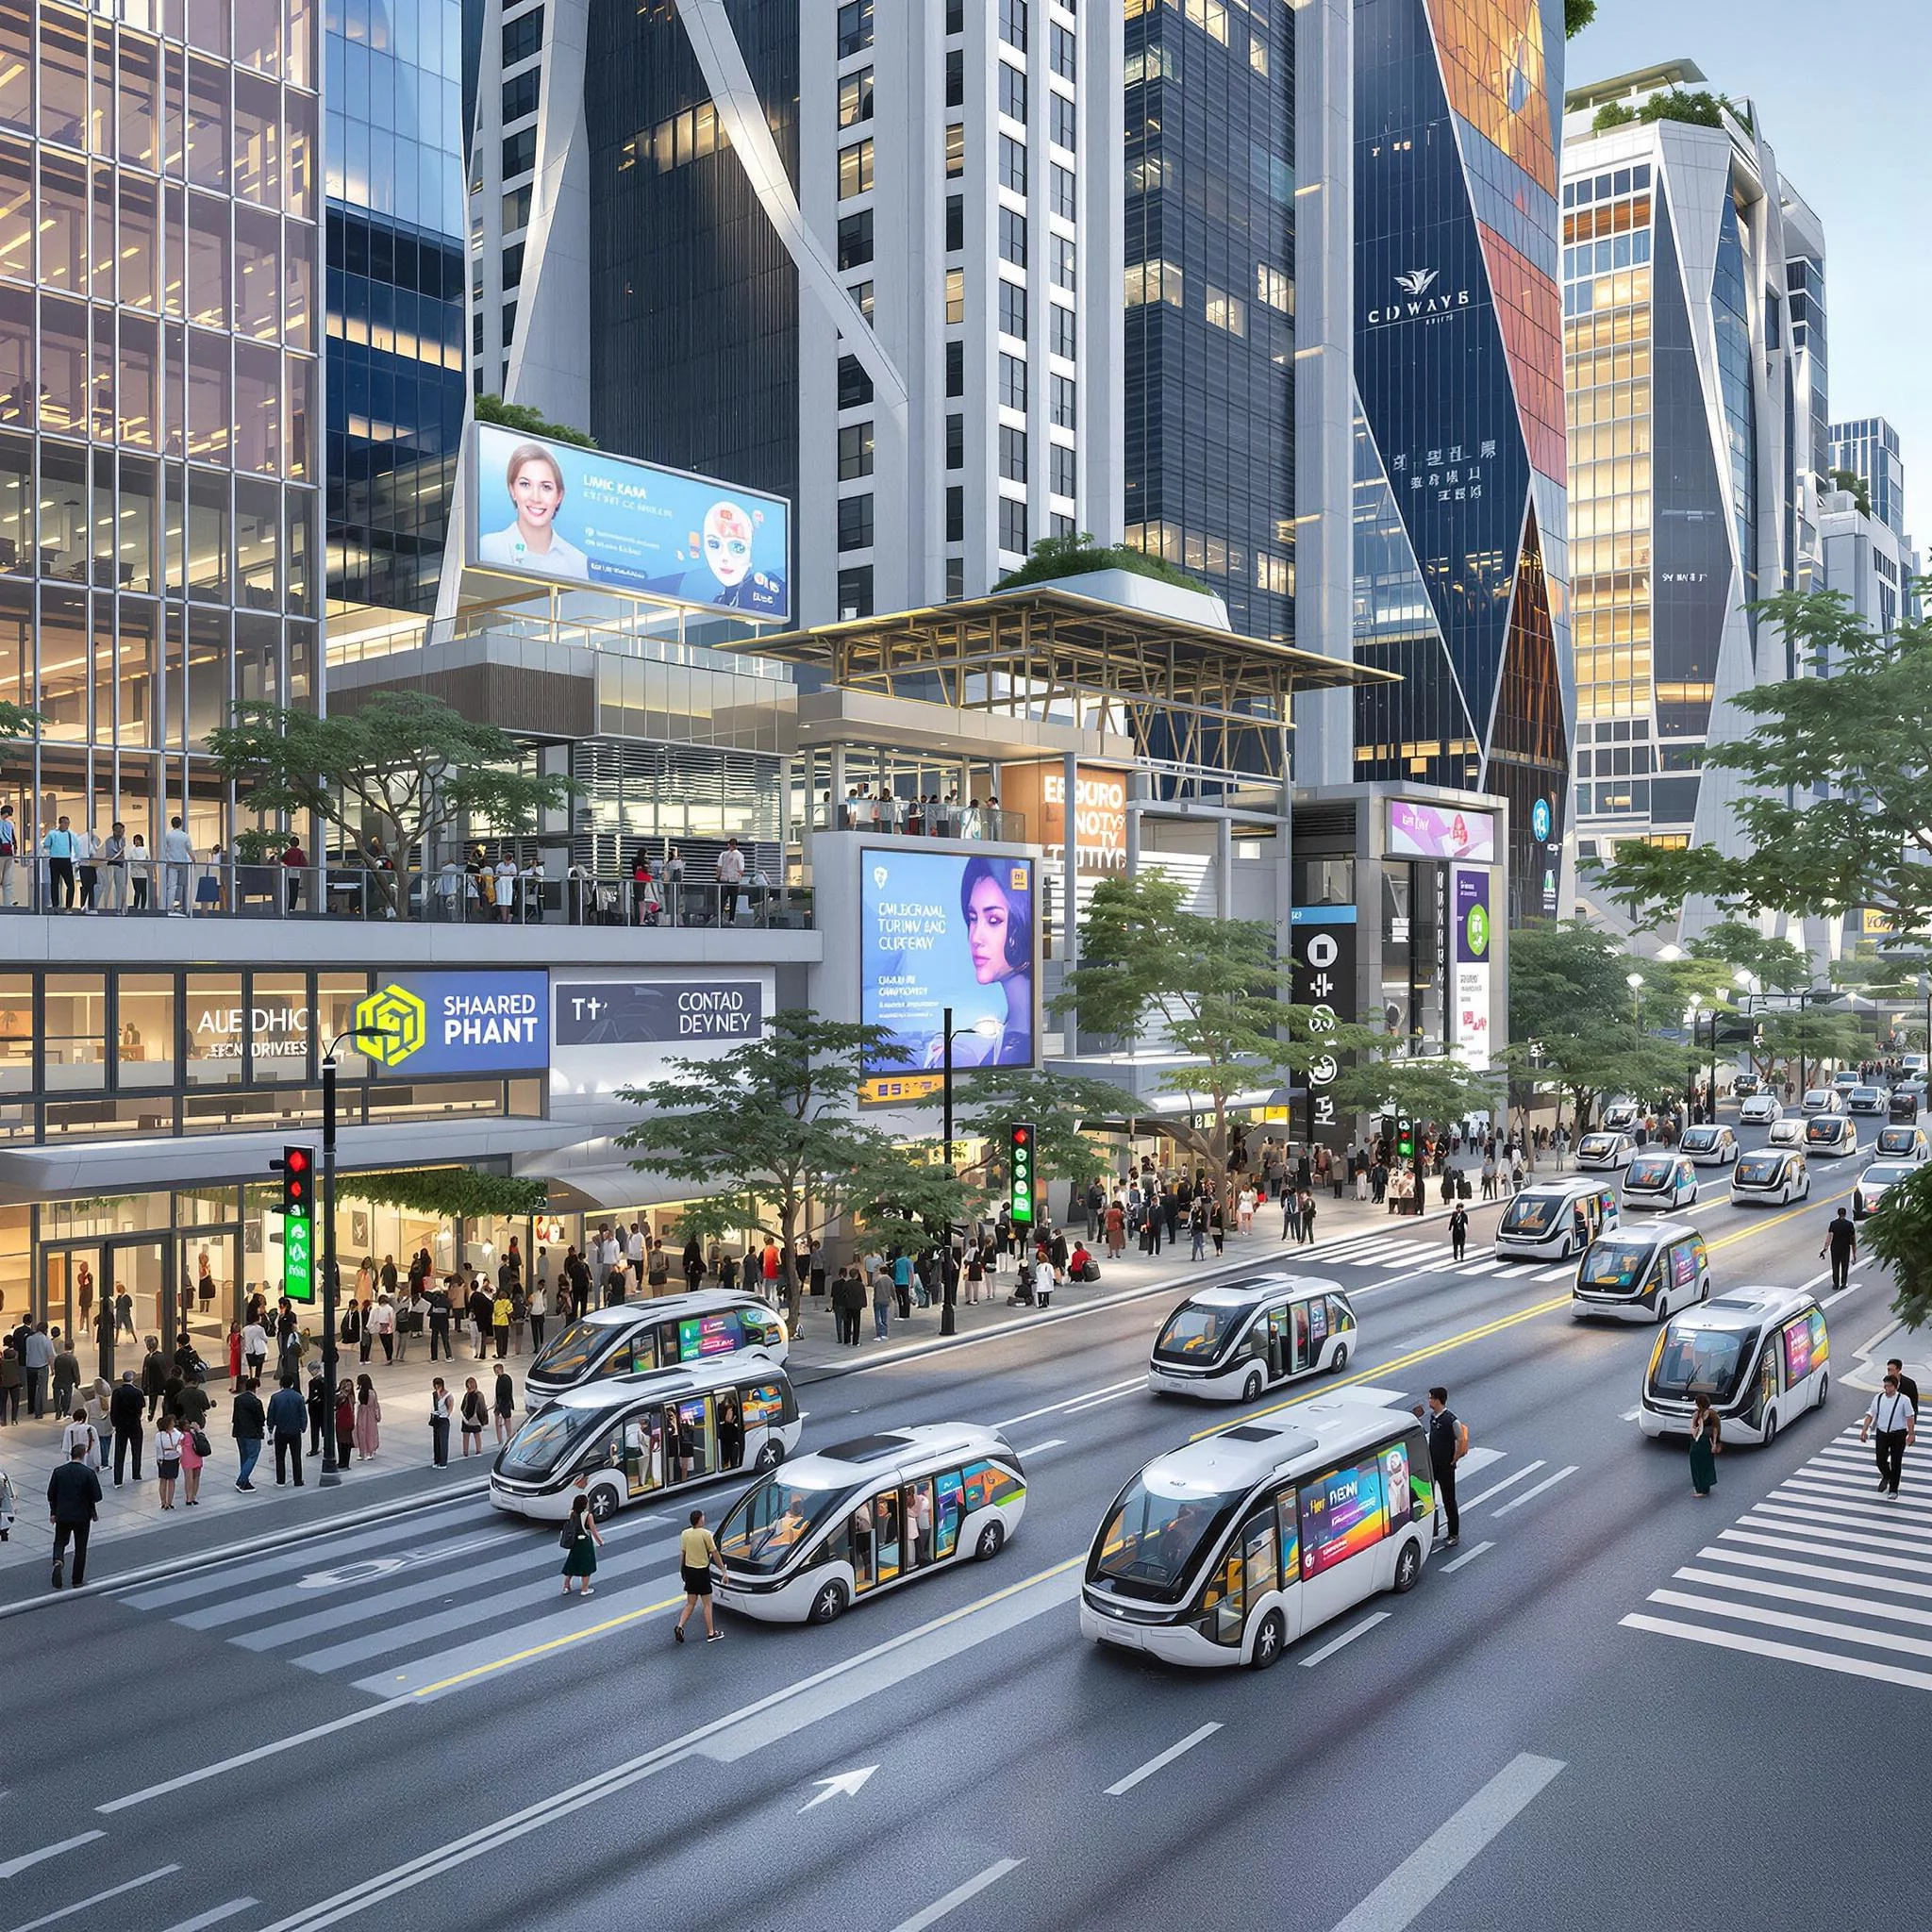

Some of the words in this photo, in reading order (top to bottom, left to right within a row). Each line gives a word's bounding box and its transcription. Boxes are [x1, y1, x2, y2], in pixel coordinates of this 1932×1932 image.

[442, 993, 537, 1016] SHAARED
[677, 991, 743, 1012] CONTAD
[444, 1017, 539, 1045] PHANT
